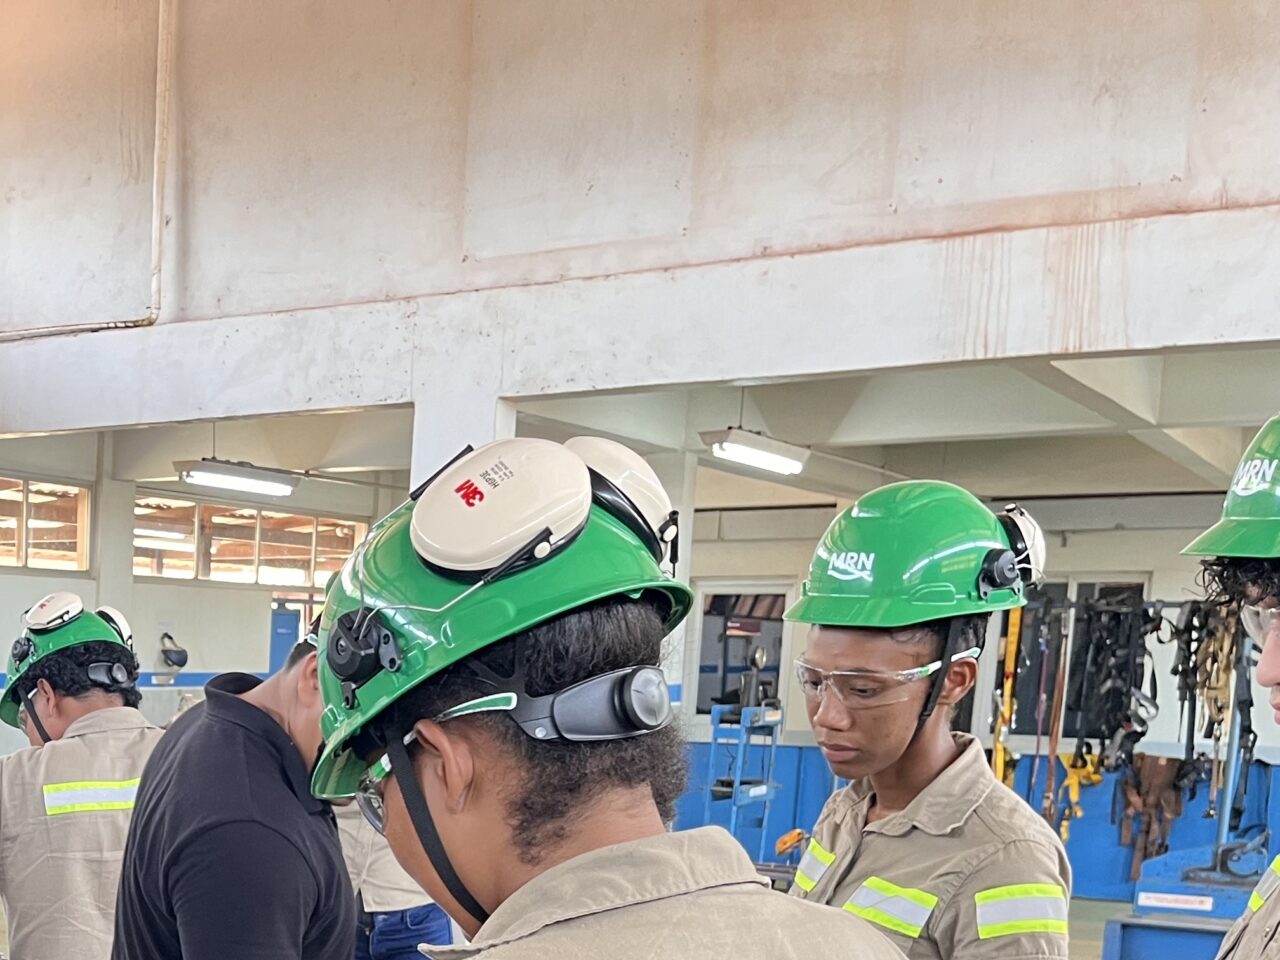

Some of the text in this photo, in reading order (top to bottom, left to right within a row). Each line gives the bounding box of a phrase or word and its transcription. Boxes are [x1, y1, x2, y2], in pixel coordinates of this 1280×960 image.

[1233, 459, 1279, 488] MRN
[454, 479, 485, 508] 3M
[828, 551, 876, 571] MRN
